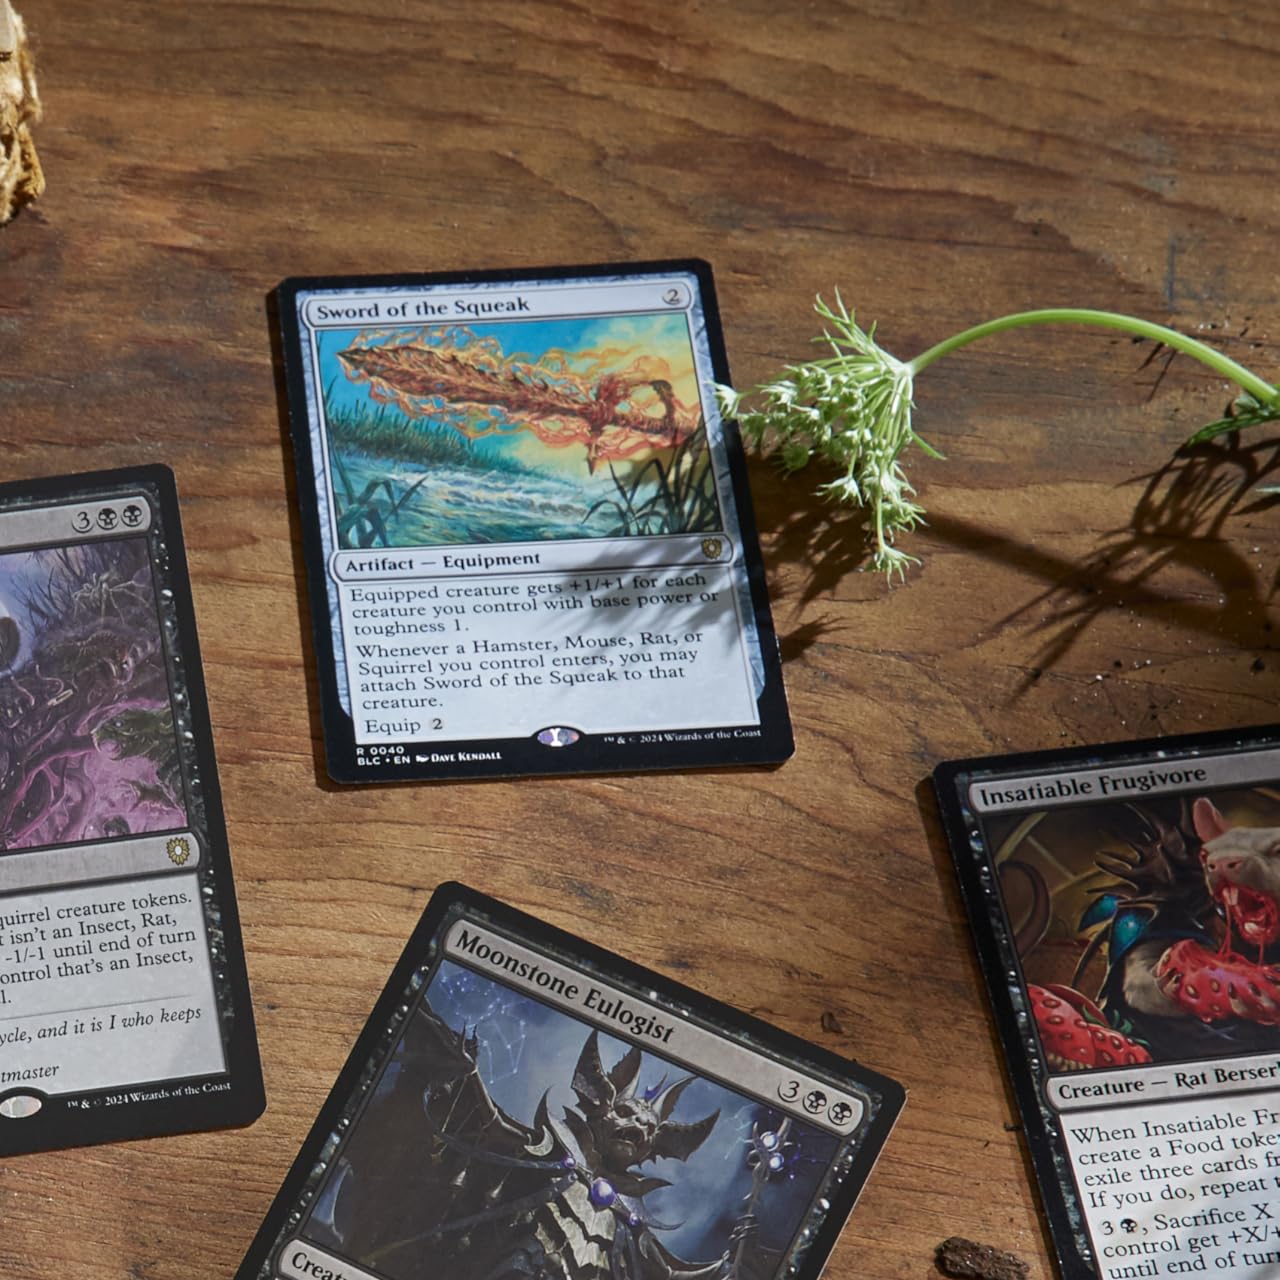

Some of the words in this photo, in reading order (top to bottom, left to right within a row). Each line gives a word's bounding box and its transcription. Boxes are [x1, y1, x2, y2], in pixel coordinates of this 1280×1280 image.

[317, 303, 379, 320] Sword
[386, 302, 408, 317] of
[415, 300, 448, 316] the
[454, 296, 530, 316] Squeak
[345, 557, 413, 572] Artifact
[442, 553, 540, 570] Equipment
[355, 644, 449, 658] Whenever
[456, 644, 465, 654] a
[472, 639, 559, 653] Hamster,
[565, 635, 634, 652] Mouse,
[639, 631, 678, 646] Rat,
[683, 626, 703, 643] or
[364, 718, 421, 736] Equip
[432, 717, 443, 730] 2
[356, 747, 364, 755] R
[369, 745, 404, 756] 0040
[357, 756, 380, 766] BLC
[393, 755, 410, 764] EN
[430, 753, 456, 763] DAVE
[457, 751, 502, 761] KENDALL
[979, 778, 1092, 806] Insatiable
[1098, 768, 1206, 795] Frugivore
[56, 900, 126, 920] creature
[131, 892, 192, 910] tokens.
[455, 929, 578, 1000] Moonstone
[582, 987, 674, 1043] Eulogist
[105, 1093, 129, 1106] 2024
[129, 1089, 170, 1102] Wizards
[171, 1086, 182, 1096] of
[184, 1085, 200, 1095] the
[201, 1082, 231, 1092] Coast
[1058, 1080, 1144, 1099] Creature
[1174, 1071, 1207, 1089] Rat
[1078, 1148, 1142, 1165] create
[1149, 1146, 1162, 1158] a
[1166, 1135, 1224, 1156] Food
[1083, 1167, 1133, 1187] exile
[1139, 1163, 1194, 1181] three
[1201, 1154, 1258, 1174] cards
